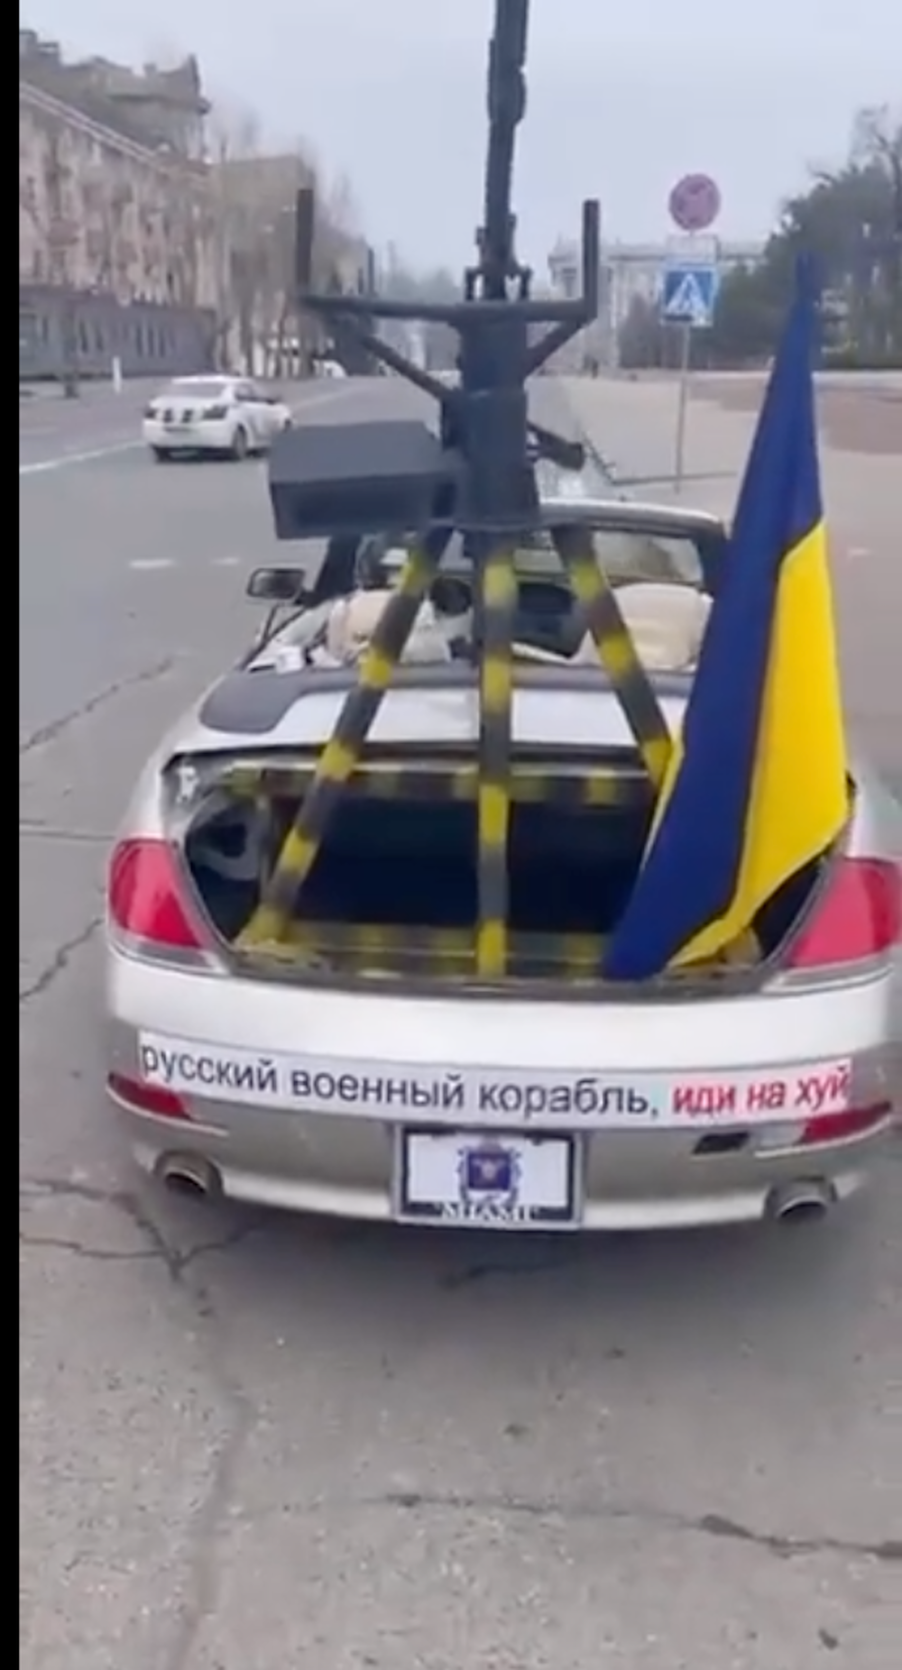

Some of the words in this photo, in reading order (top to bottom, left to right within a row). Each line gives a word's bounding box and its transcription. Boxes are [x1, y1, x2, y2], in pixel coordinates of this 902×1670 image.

[142, 1045, 278, 1092] русский
[292, 1070, 465, 1109] военный
[479, 1078, 659, 1118] корабль,
[673, 1087, 735, 1116] иди
[747, 1083, 786, 1109] на
[797, 1066, 850, 1110] хуй
